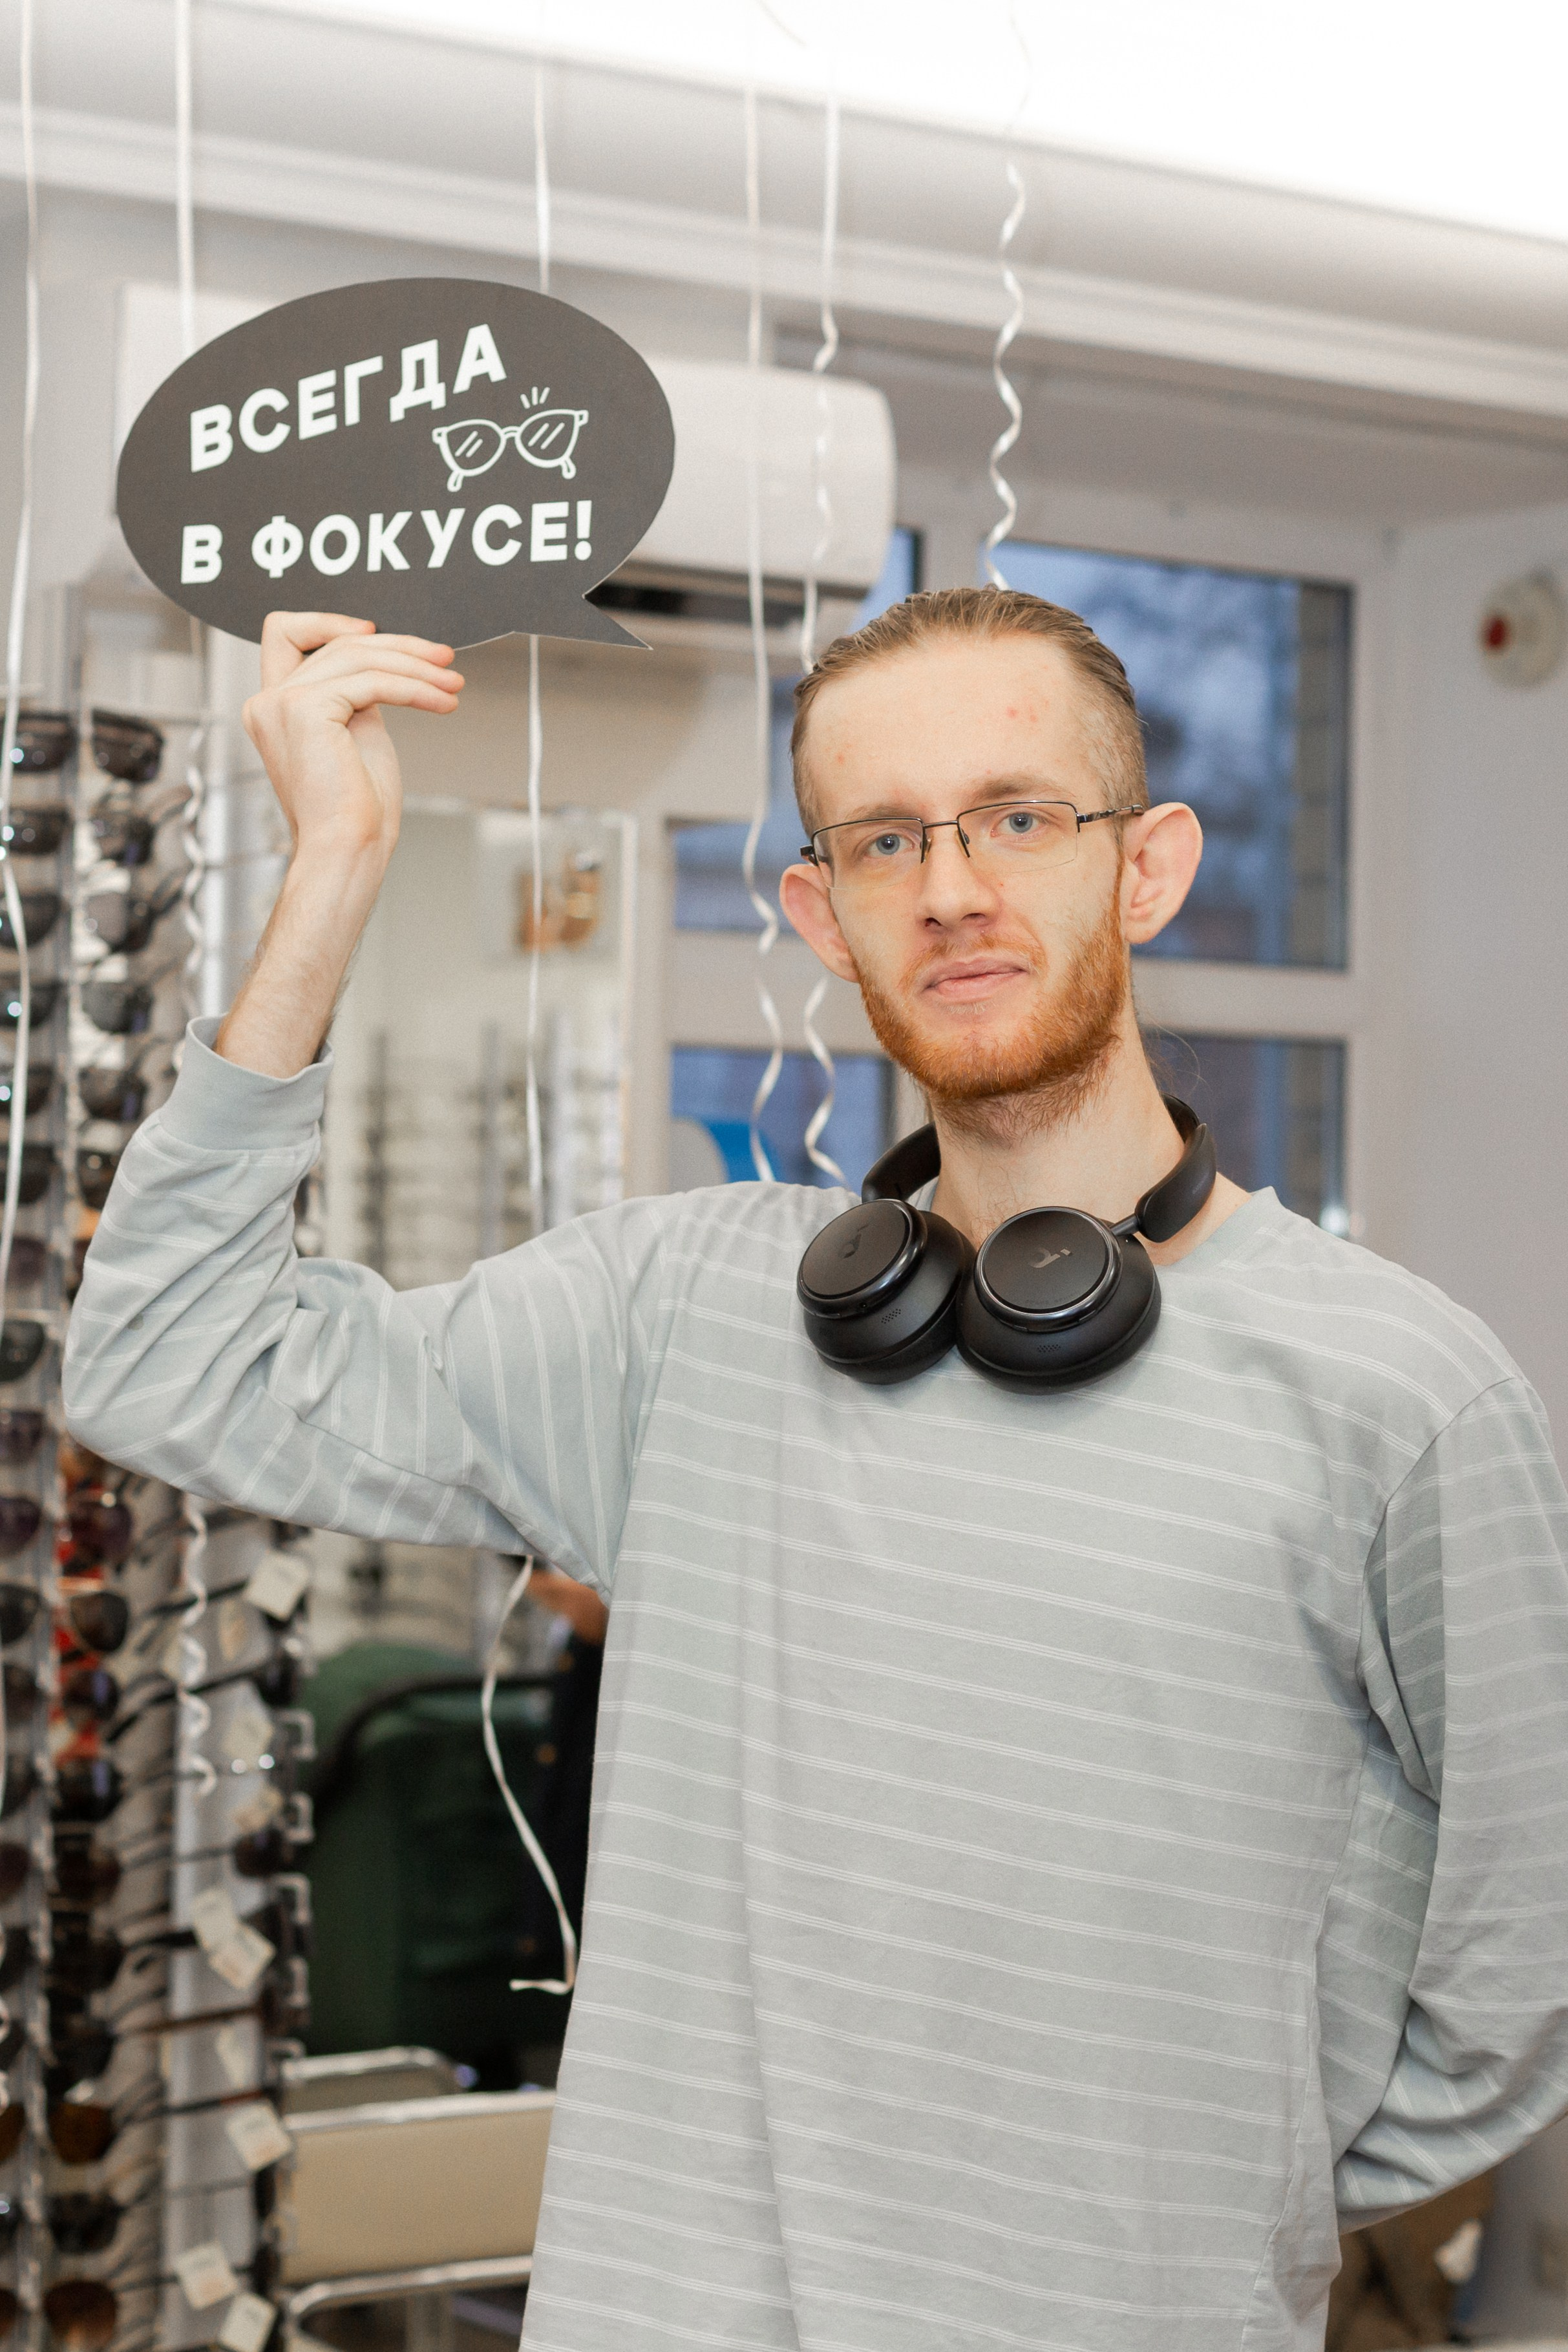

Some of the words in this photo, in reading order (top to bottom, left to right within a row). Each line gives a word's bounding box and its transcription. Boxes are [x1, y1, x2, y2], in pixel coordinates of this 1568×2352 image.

[189, 323, 507, 472] ВСЕГДА
[180, 524, 223, 584] В
[251, 499, 593, 578] ФОКУСЕ!
